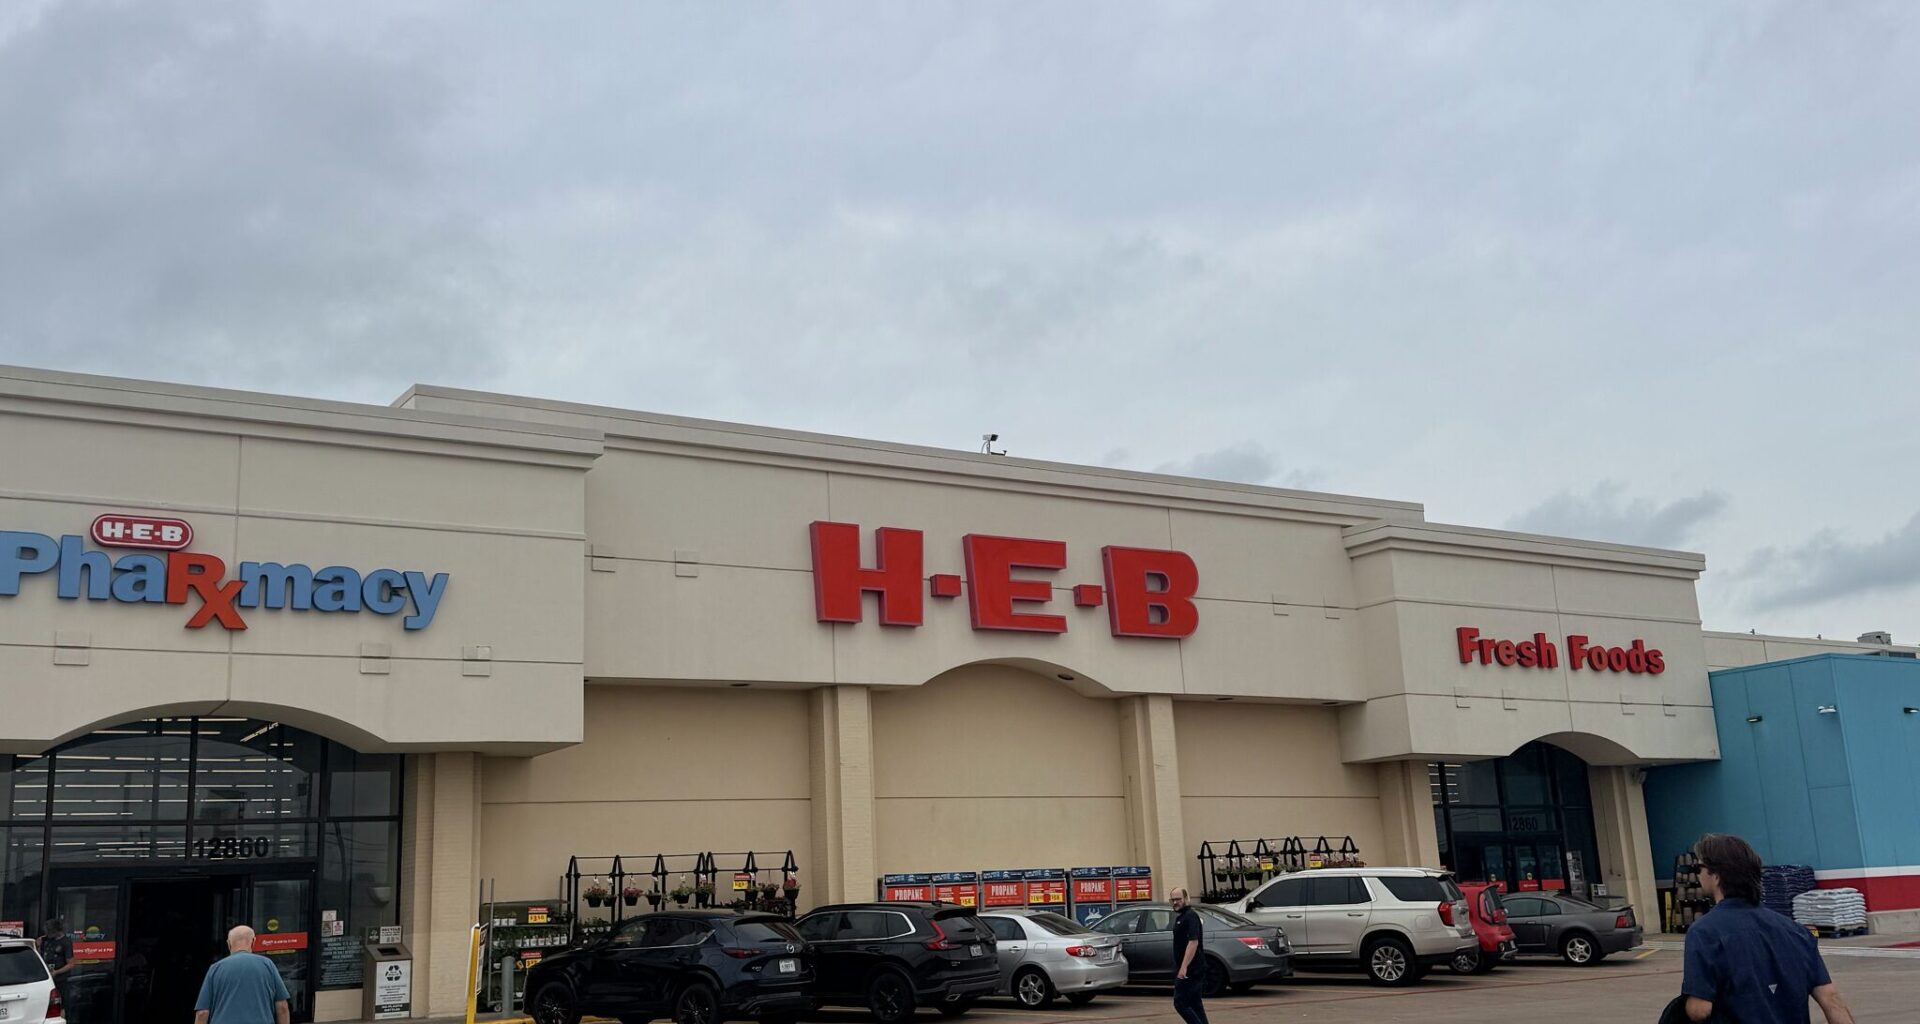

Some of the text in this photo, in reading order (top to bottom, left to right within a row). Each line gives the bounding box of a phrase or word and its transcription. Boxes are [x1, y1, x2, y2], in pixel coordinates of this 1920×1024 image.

[102, 521, 184, 542] H-E-B
[809, 520, 1200, 639] H-E-B
[1456, 627, 1665, 674] Fresh Foods
[194, 836, 269, 858] 12860
[894, 889, 923, 901] PROPANE
[991, 885, 1017, 896] PROPANE
[1080, 882, 1105, 893] PROPANE
